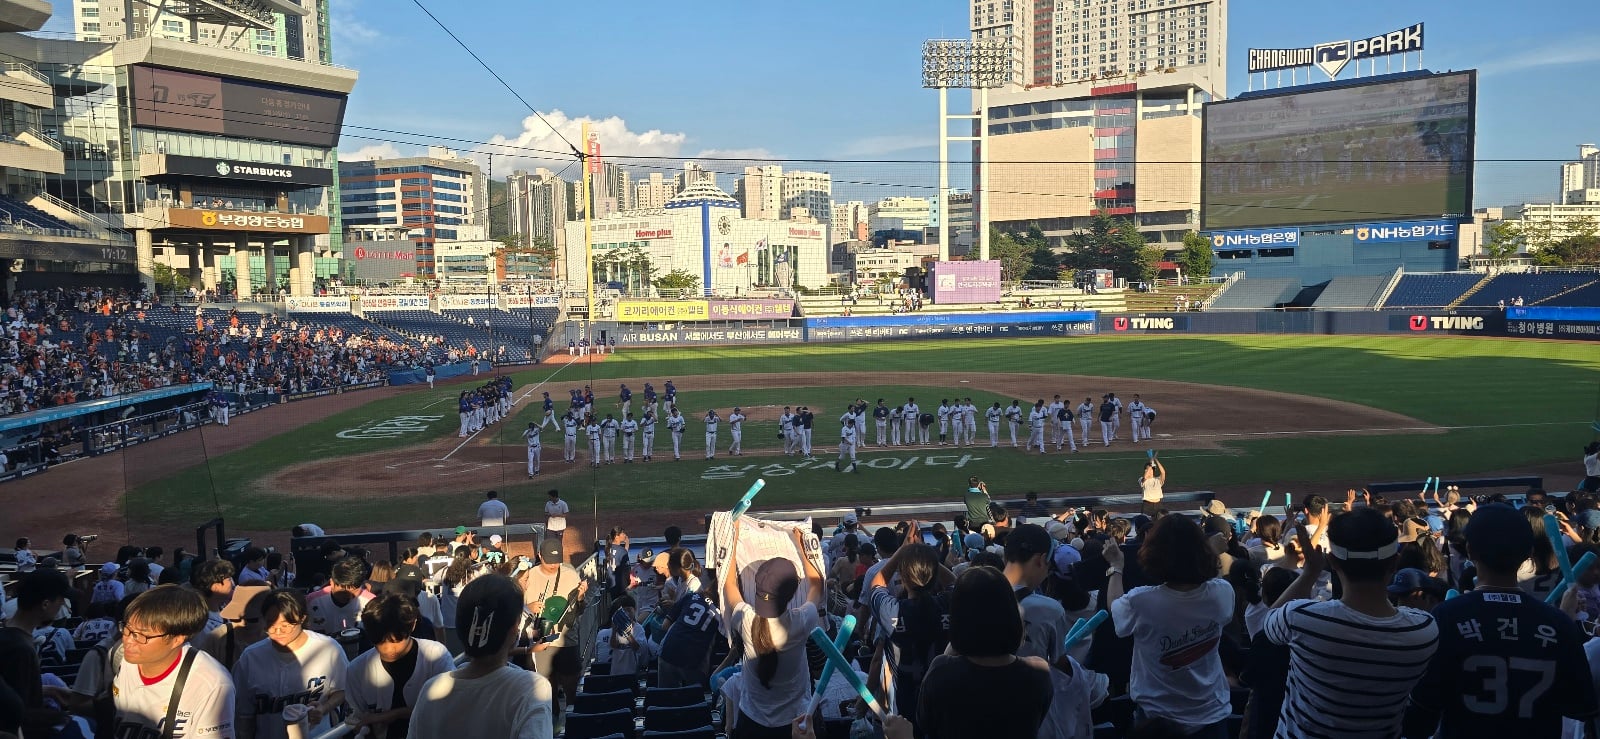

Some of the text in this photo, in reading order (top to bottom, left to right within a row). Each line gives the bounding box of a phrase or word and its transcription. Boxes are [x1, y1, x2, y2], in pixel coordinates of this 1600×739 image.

[1249, 48, 1312, 71] CHANGWON
[1353, 24, 1423, 58] PARK
[233, 165, 293, 179] STARBUCKS
[218, 213, 304, 230] 부경양돈농협
[635, 229, 672, 239] Home plus
[788, 227, 822, 237] Home plus
[1226, 230, 1298, 246] NH농협은행
[1371, 224, 1454, 239] NH농협카드
[101, 247, 127, 260] 17:12
[623, 305, 676, 317] 코끼리에어컨
[712, 304, 763, 315] 이동식에어컨
[1131, 317, 1174, 330] TVING
[1431, 316, 1484, 330] TVING
[1518, 321, 1554, 335] 청아병원
[622, 333, 638, 342] AIR
[639, 332, 679, 342] BUSAN
[684, 331, 725, 341] 서울에서도
[726, 330, 766, 340] 부산에서도
[1456, 617, 1558, 648] 박건우
[1463, 655, 1557, 718] 37
